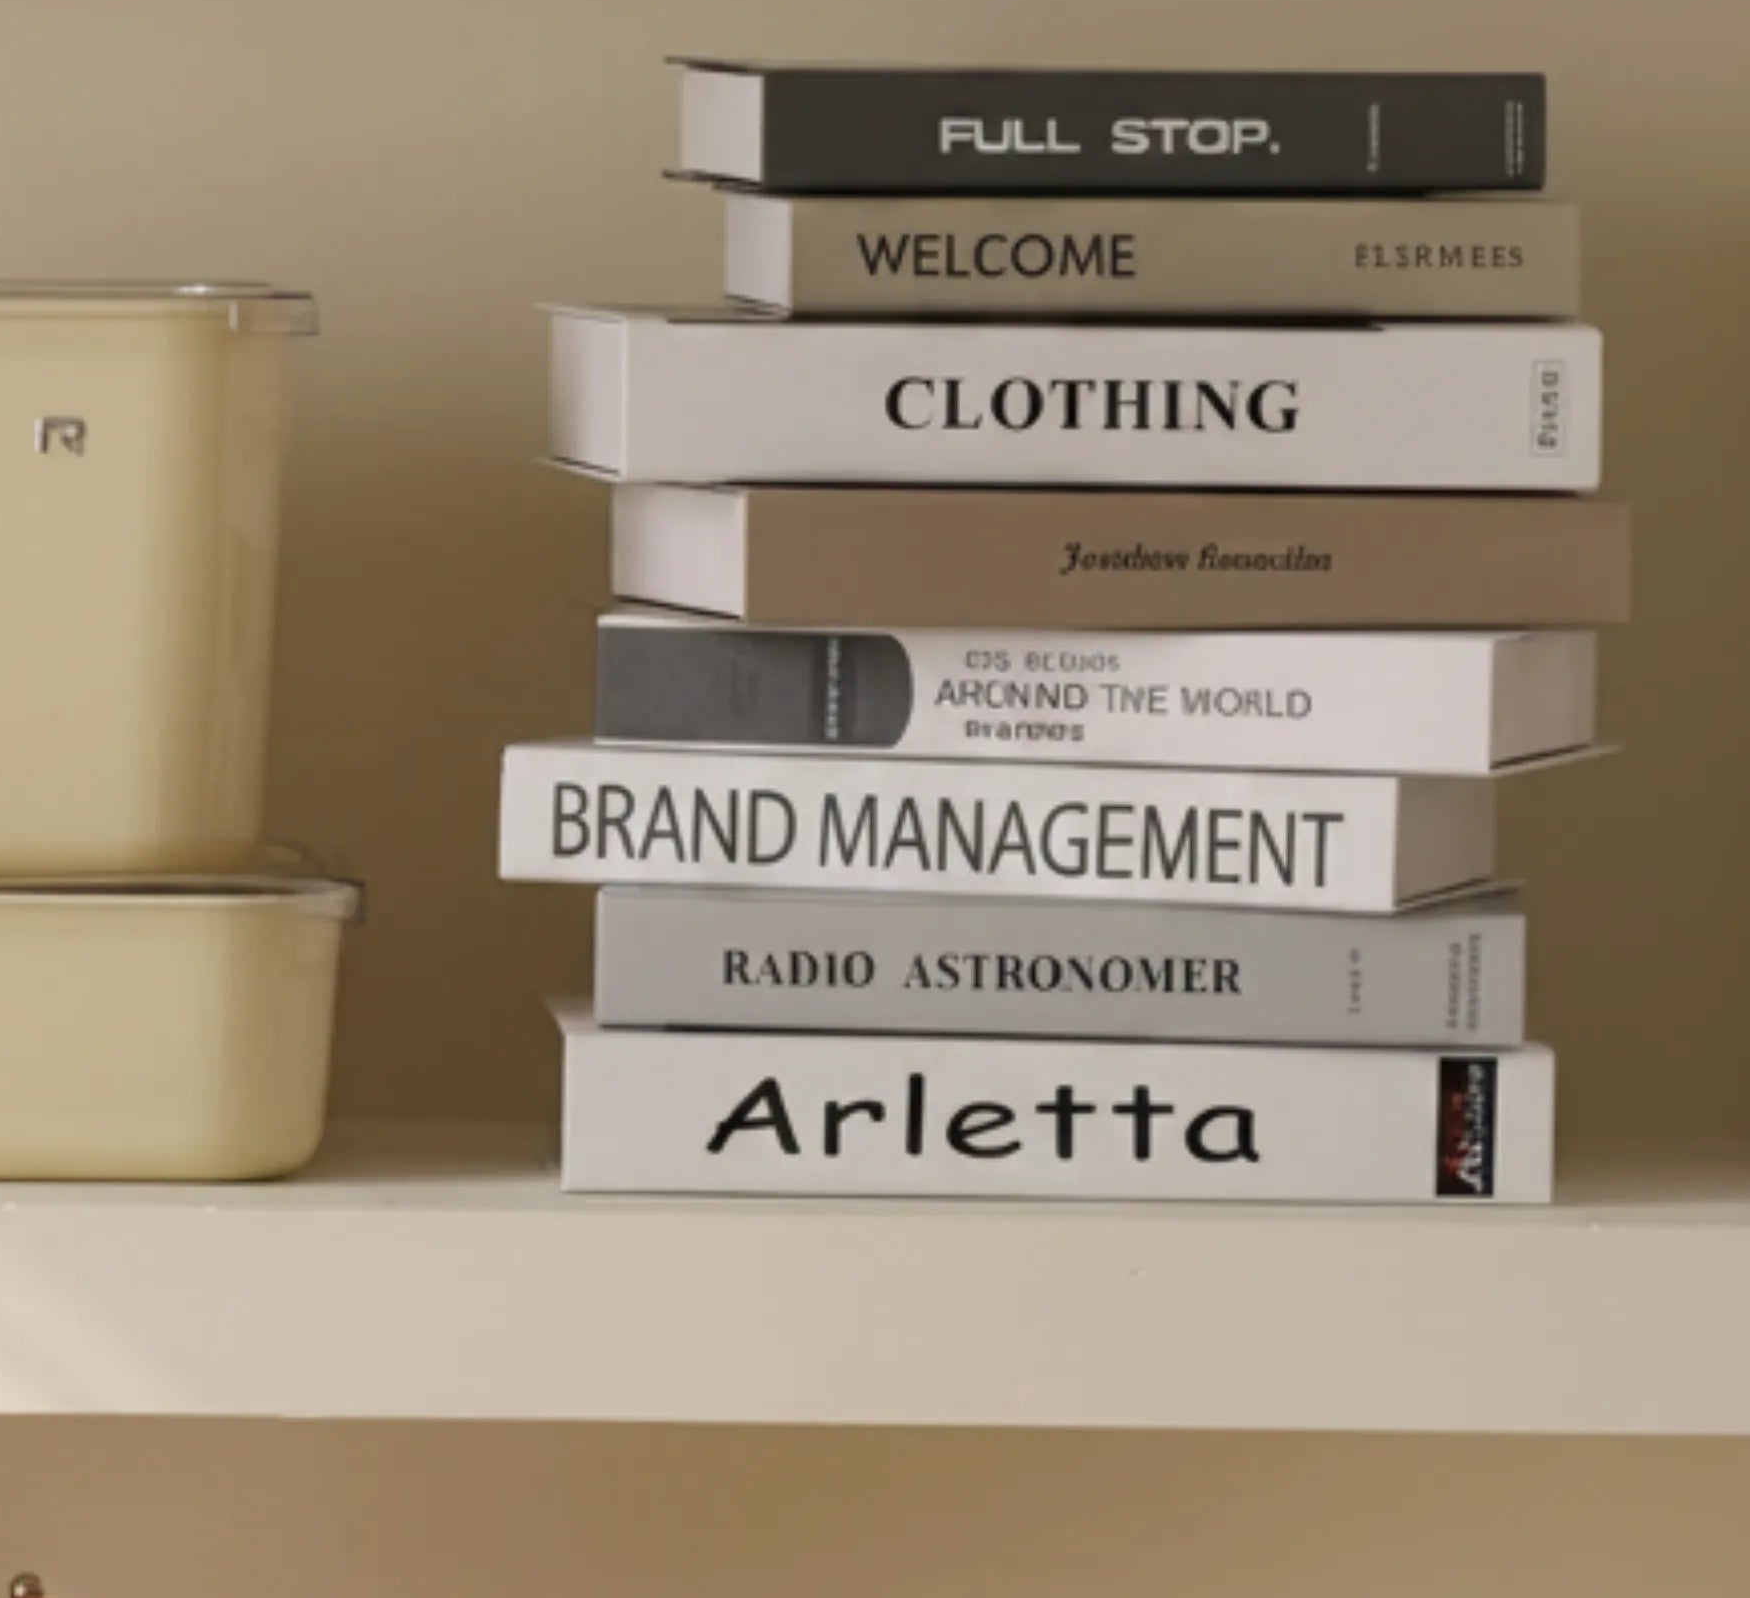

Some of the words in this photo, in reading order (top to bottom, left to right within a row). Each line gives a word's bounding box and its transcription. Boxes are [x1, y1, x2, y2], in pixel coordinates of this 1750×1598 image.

[939, 117, 1081, 155] FULL
[1109, 117, 1281, 156] STOP.
[856, 233, 1137, 279] WELCOME
[885, 376, 1301, 434] CLOTHING
[549, 781, 798, 867] BRAND
[818, 793, 1345, 888] MANAGEMENT
[723, 949, 876, 988] RADIO
[903, 953, 1242, 995] ASTRONOMER
[707, 1074, 1260, 1164] Arletta
